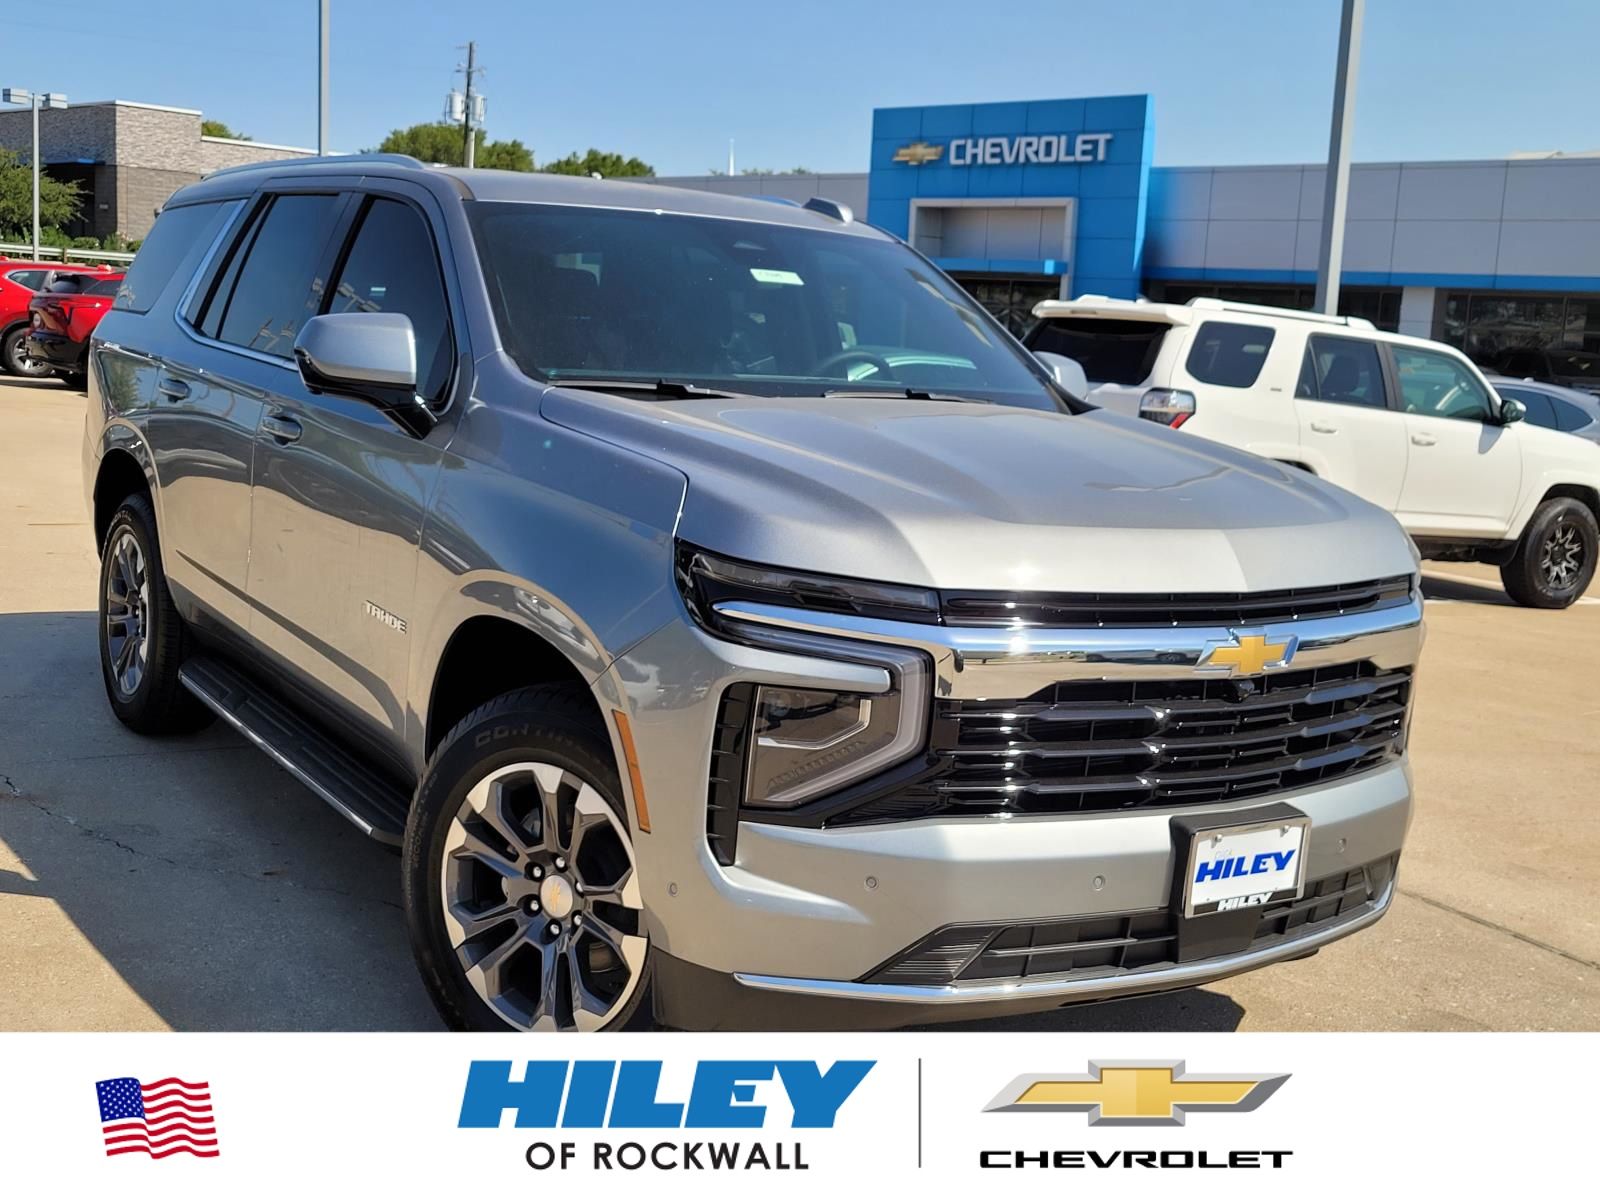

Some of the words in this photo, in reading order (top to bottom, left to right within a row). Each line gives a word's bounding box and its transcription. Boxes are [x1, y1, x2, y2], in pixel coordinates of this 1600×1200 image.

[949, 133, 1113, 165] CHEVROLET
[365, 600, 408, 635] TAHOE
[1195, 849, 1296, 883] HILEY
[1217, 892, 1274, 912] HILEY
